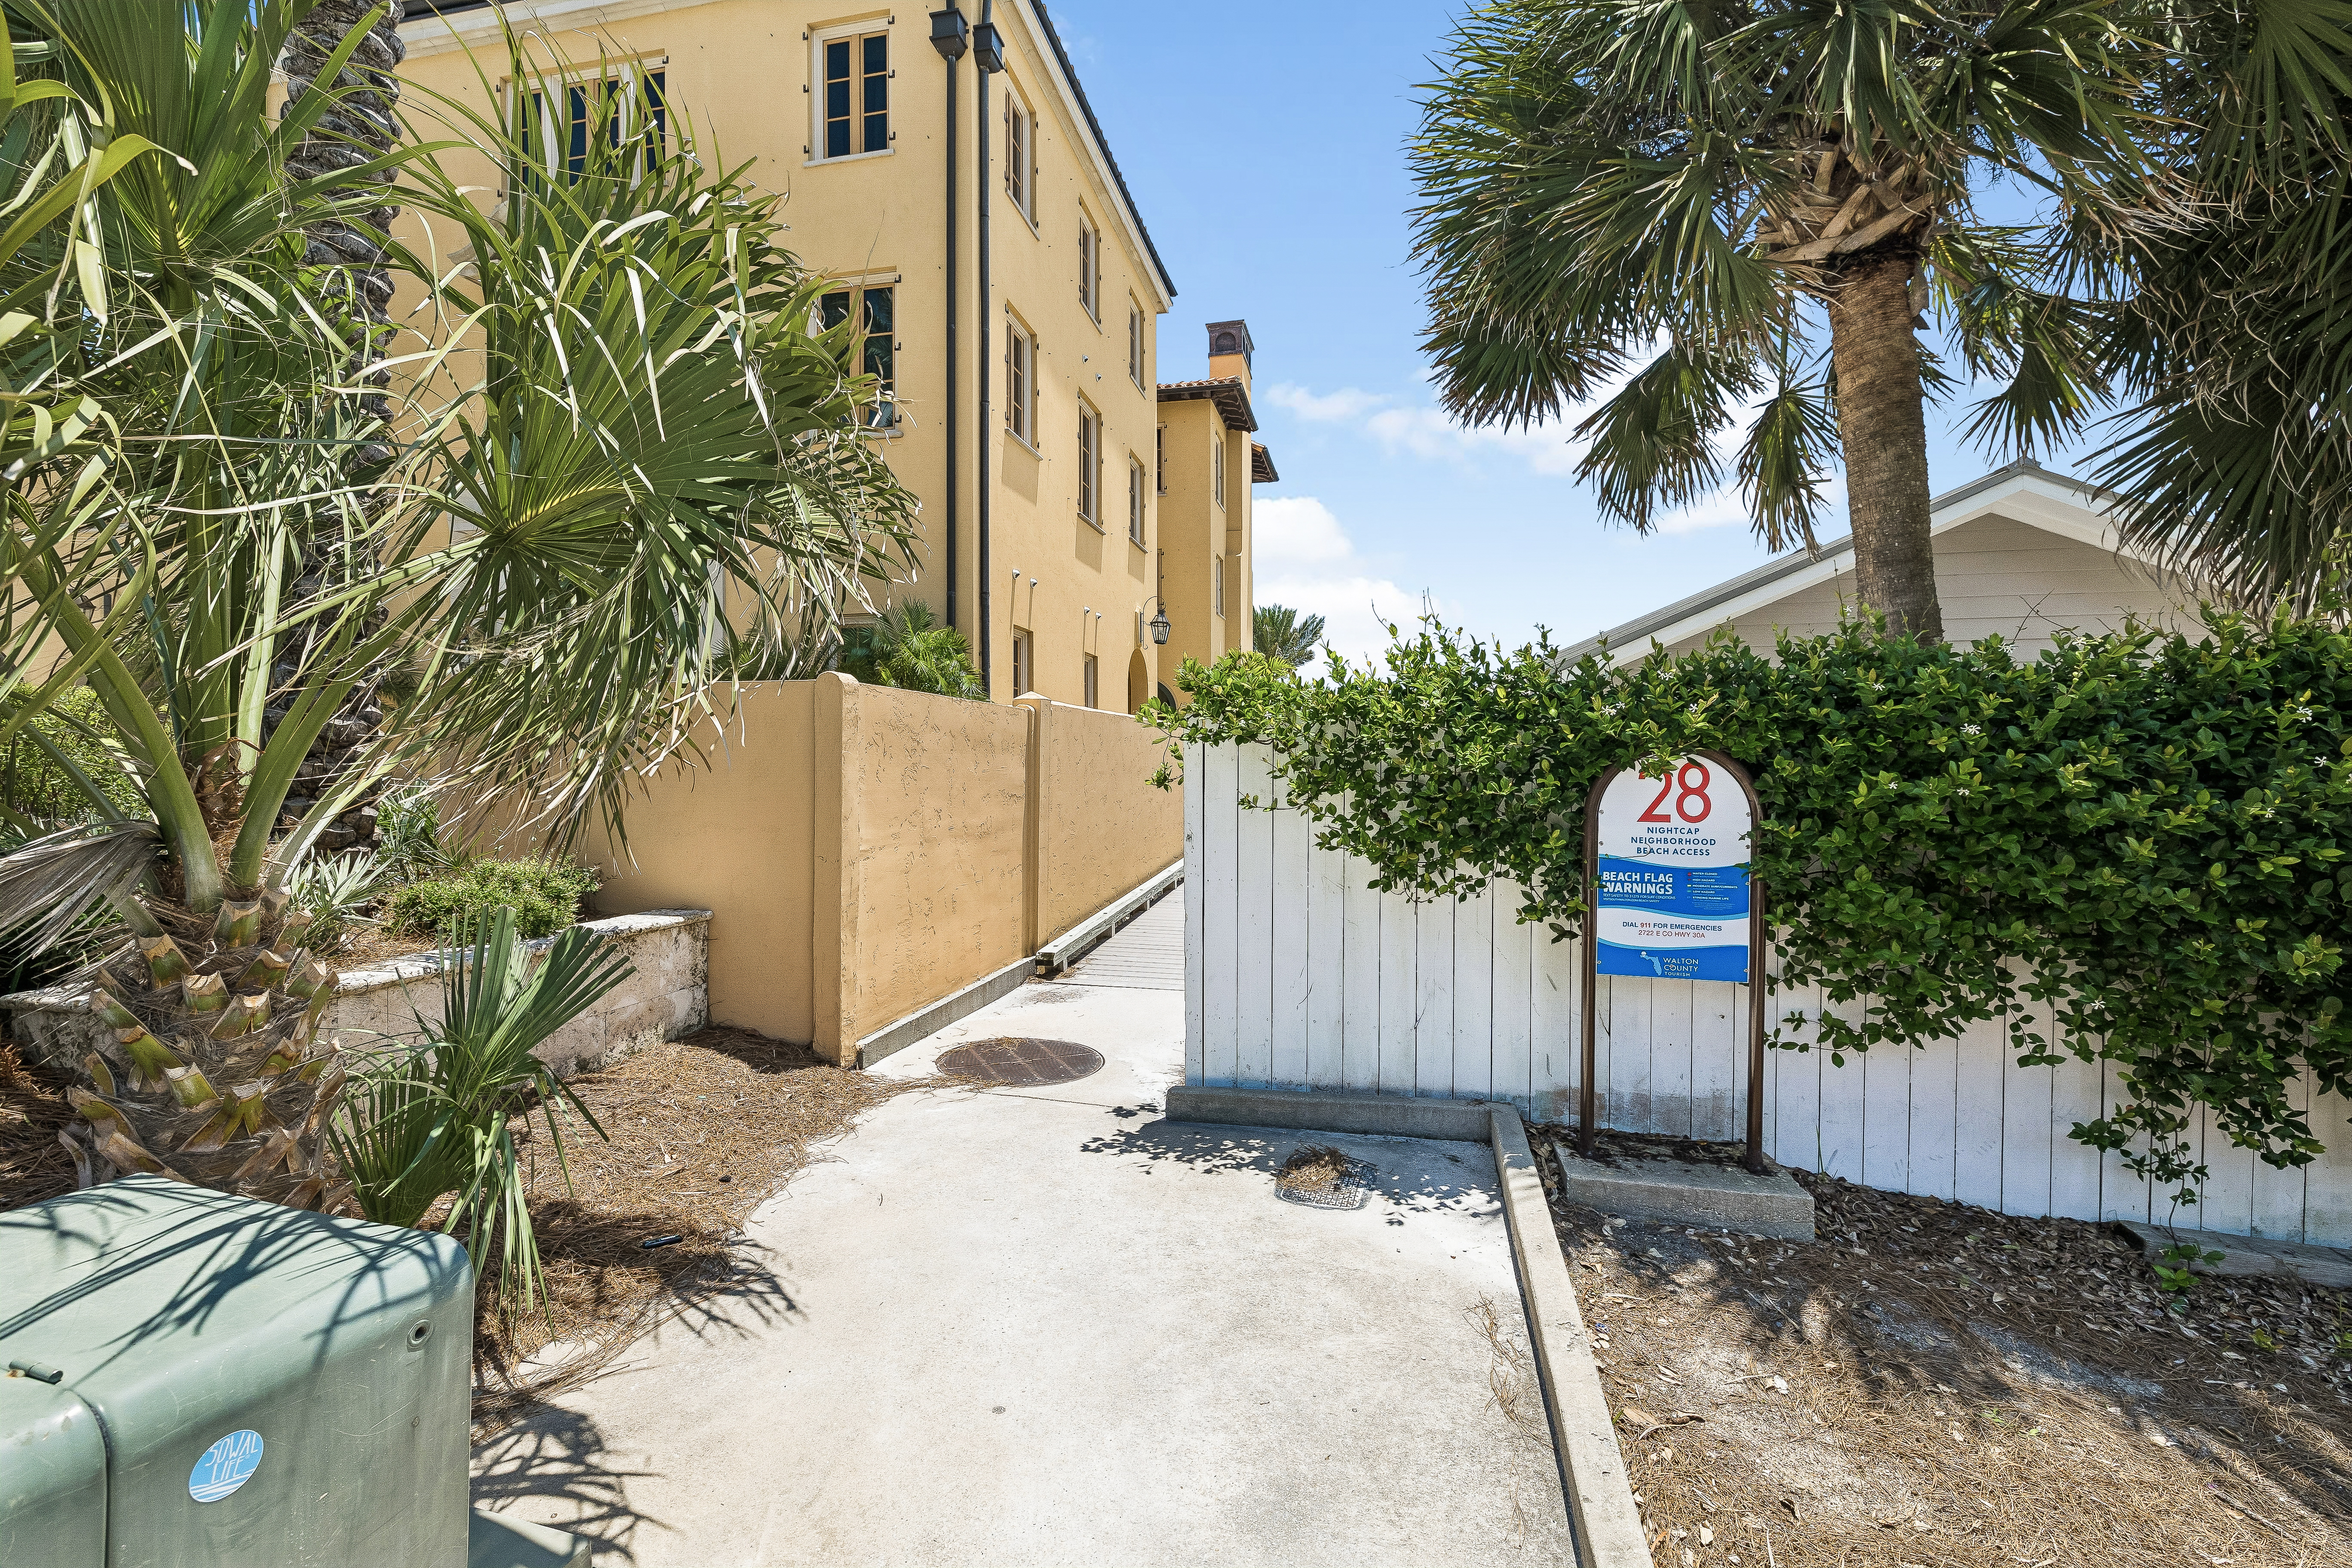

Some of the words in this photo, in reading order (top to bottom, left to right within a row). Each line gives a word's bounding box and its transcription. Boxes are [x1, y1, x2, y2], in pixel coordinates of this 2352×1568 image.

[1637, 762, 1711, 823] 28
[1647, 827, 1700, 835] NIGHTCAP
[1631, 836, 1716, 846] NEIGHBORHOOD
[1603, 871, 1640, 882] BEACH
[1645, 873, 1673, 883] FLAG
[1602, 882, 1673, 894] WARNINGS
[205, 1432, 258, 1467] SOWAL
[211, 1455, 247, 1484] LIFE
